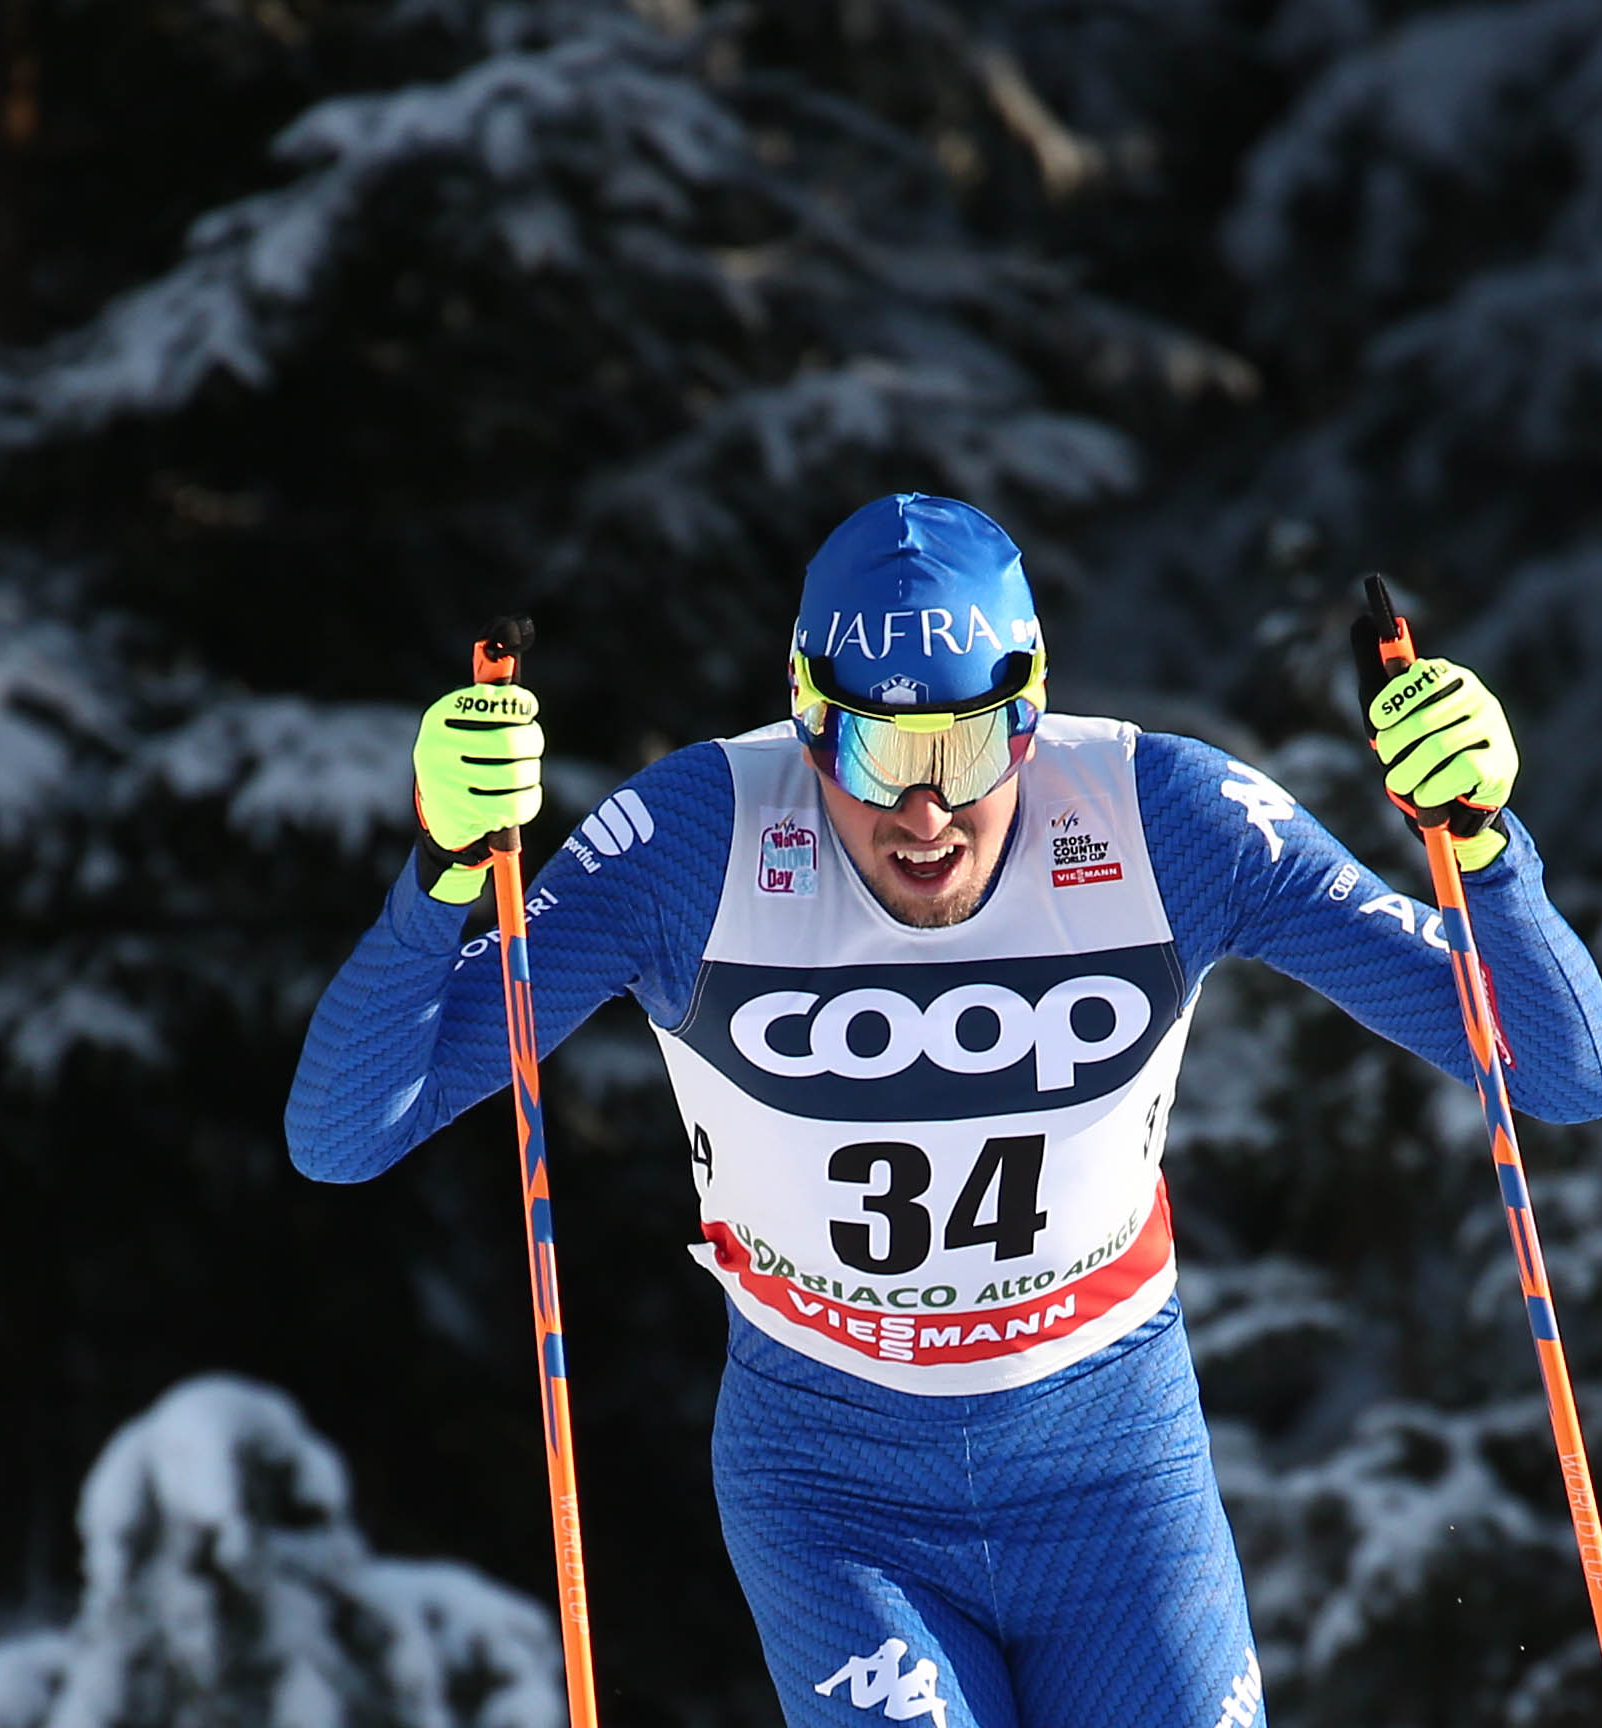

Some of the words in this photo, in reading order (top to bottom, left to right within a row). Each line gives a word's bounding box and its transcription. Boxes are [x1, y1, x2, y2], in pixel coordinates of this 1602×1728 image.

[763, 841, 811, 870] Snow
[1053, 835, 1091, 847] CROSS
[1054, 841, 1108, 857] COUNTRY
[1054, 855, 1087, 865] WORLD
[1089, 852, 1106, 861] CUP
[768, 868, 793, 889] Day
[729, 975, 1152, 1092] coop
[828, 1134, 1047, 1275] 34
[787, 1288, 1076, 1362] VIESSMANN
[1561, 1453, 1598, 1538] WORLD
